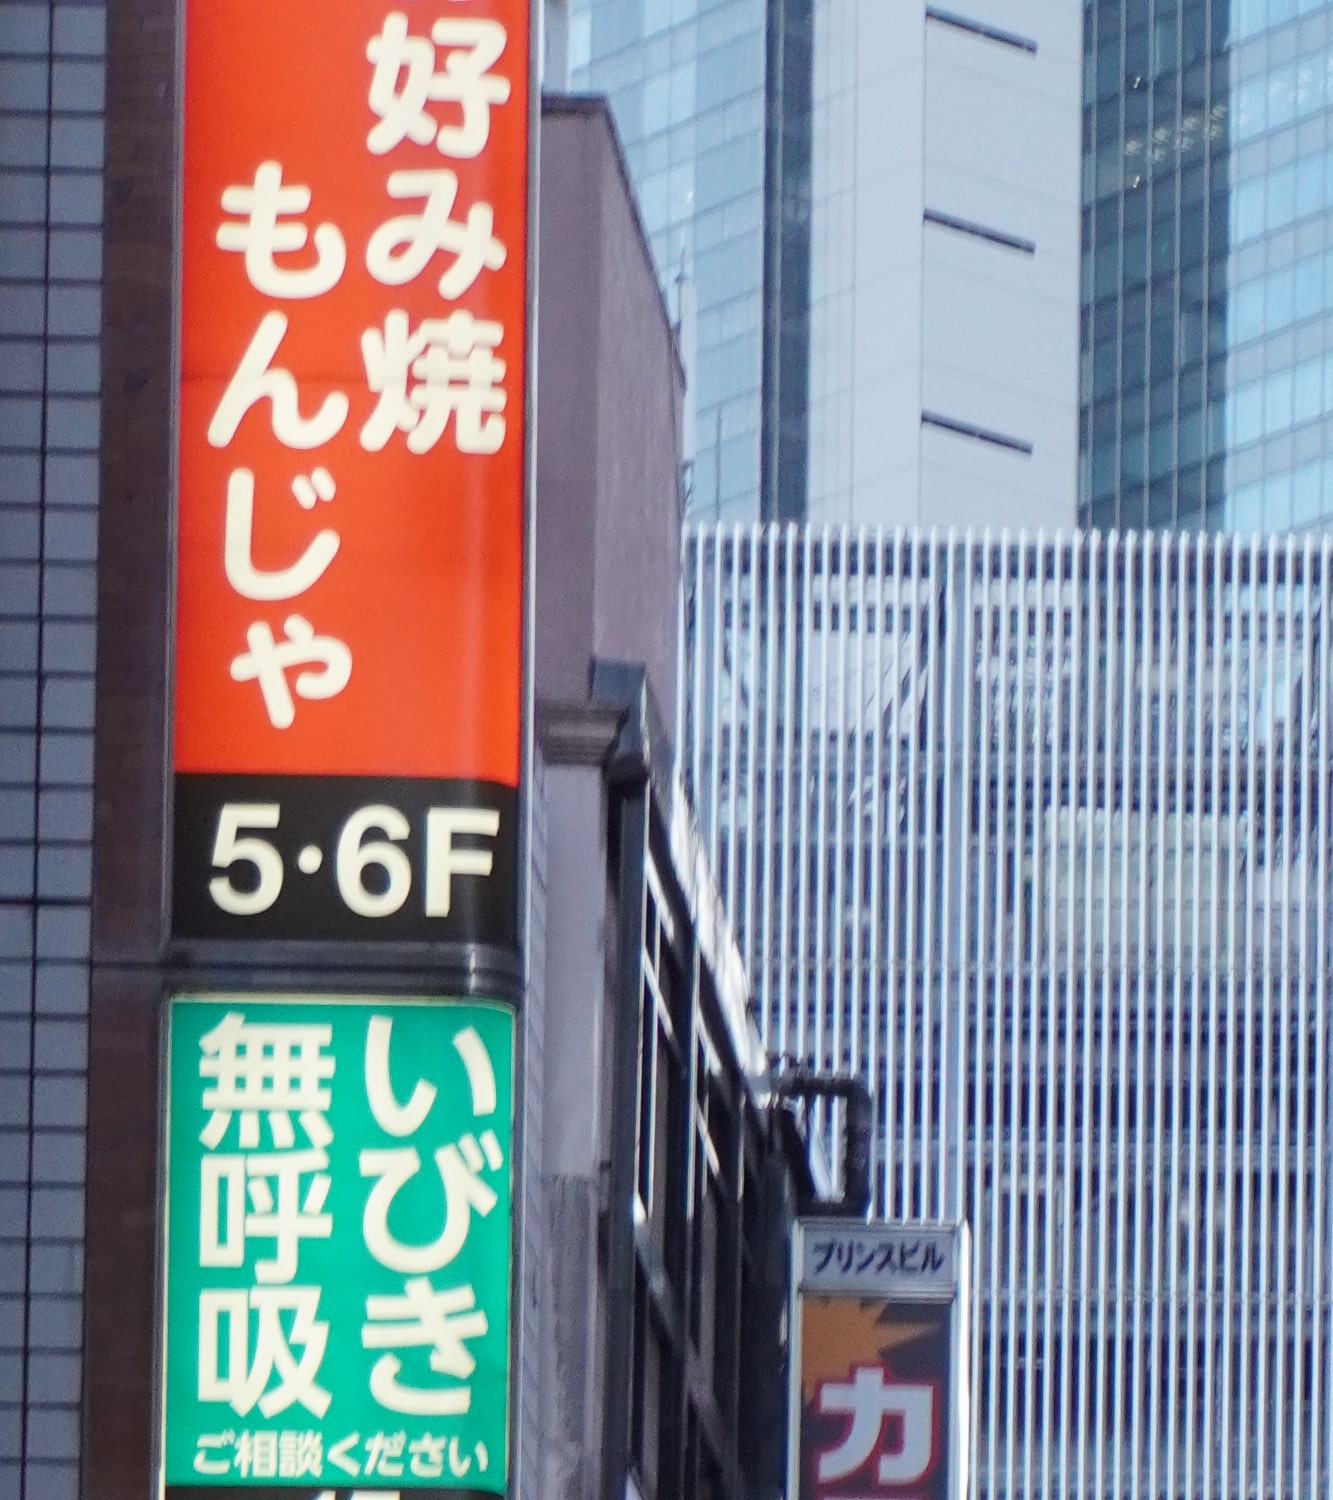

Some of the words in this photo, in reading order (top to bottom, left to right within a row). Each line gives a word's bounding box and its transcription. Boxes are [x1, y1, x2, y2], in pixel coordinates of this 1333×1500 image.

[207, 160, 353, 730] もんじゃ
[199, 1012, 335, 1419] 無呼吸
[359, 1015, 503, 1416] いびき
[812, 1242, 944, 1276] プリンスビル
[193, 1432, 489, 1480] ご相談ください
